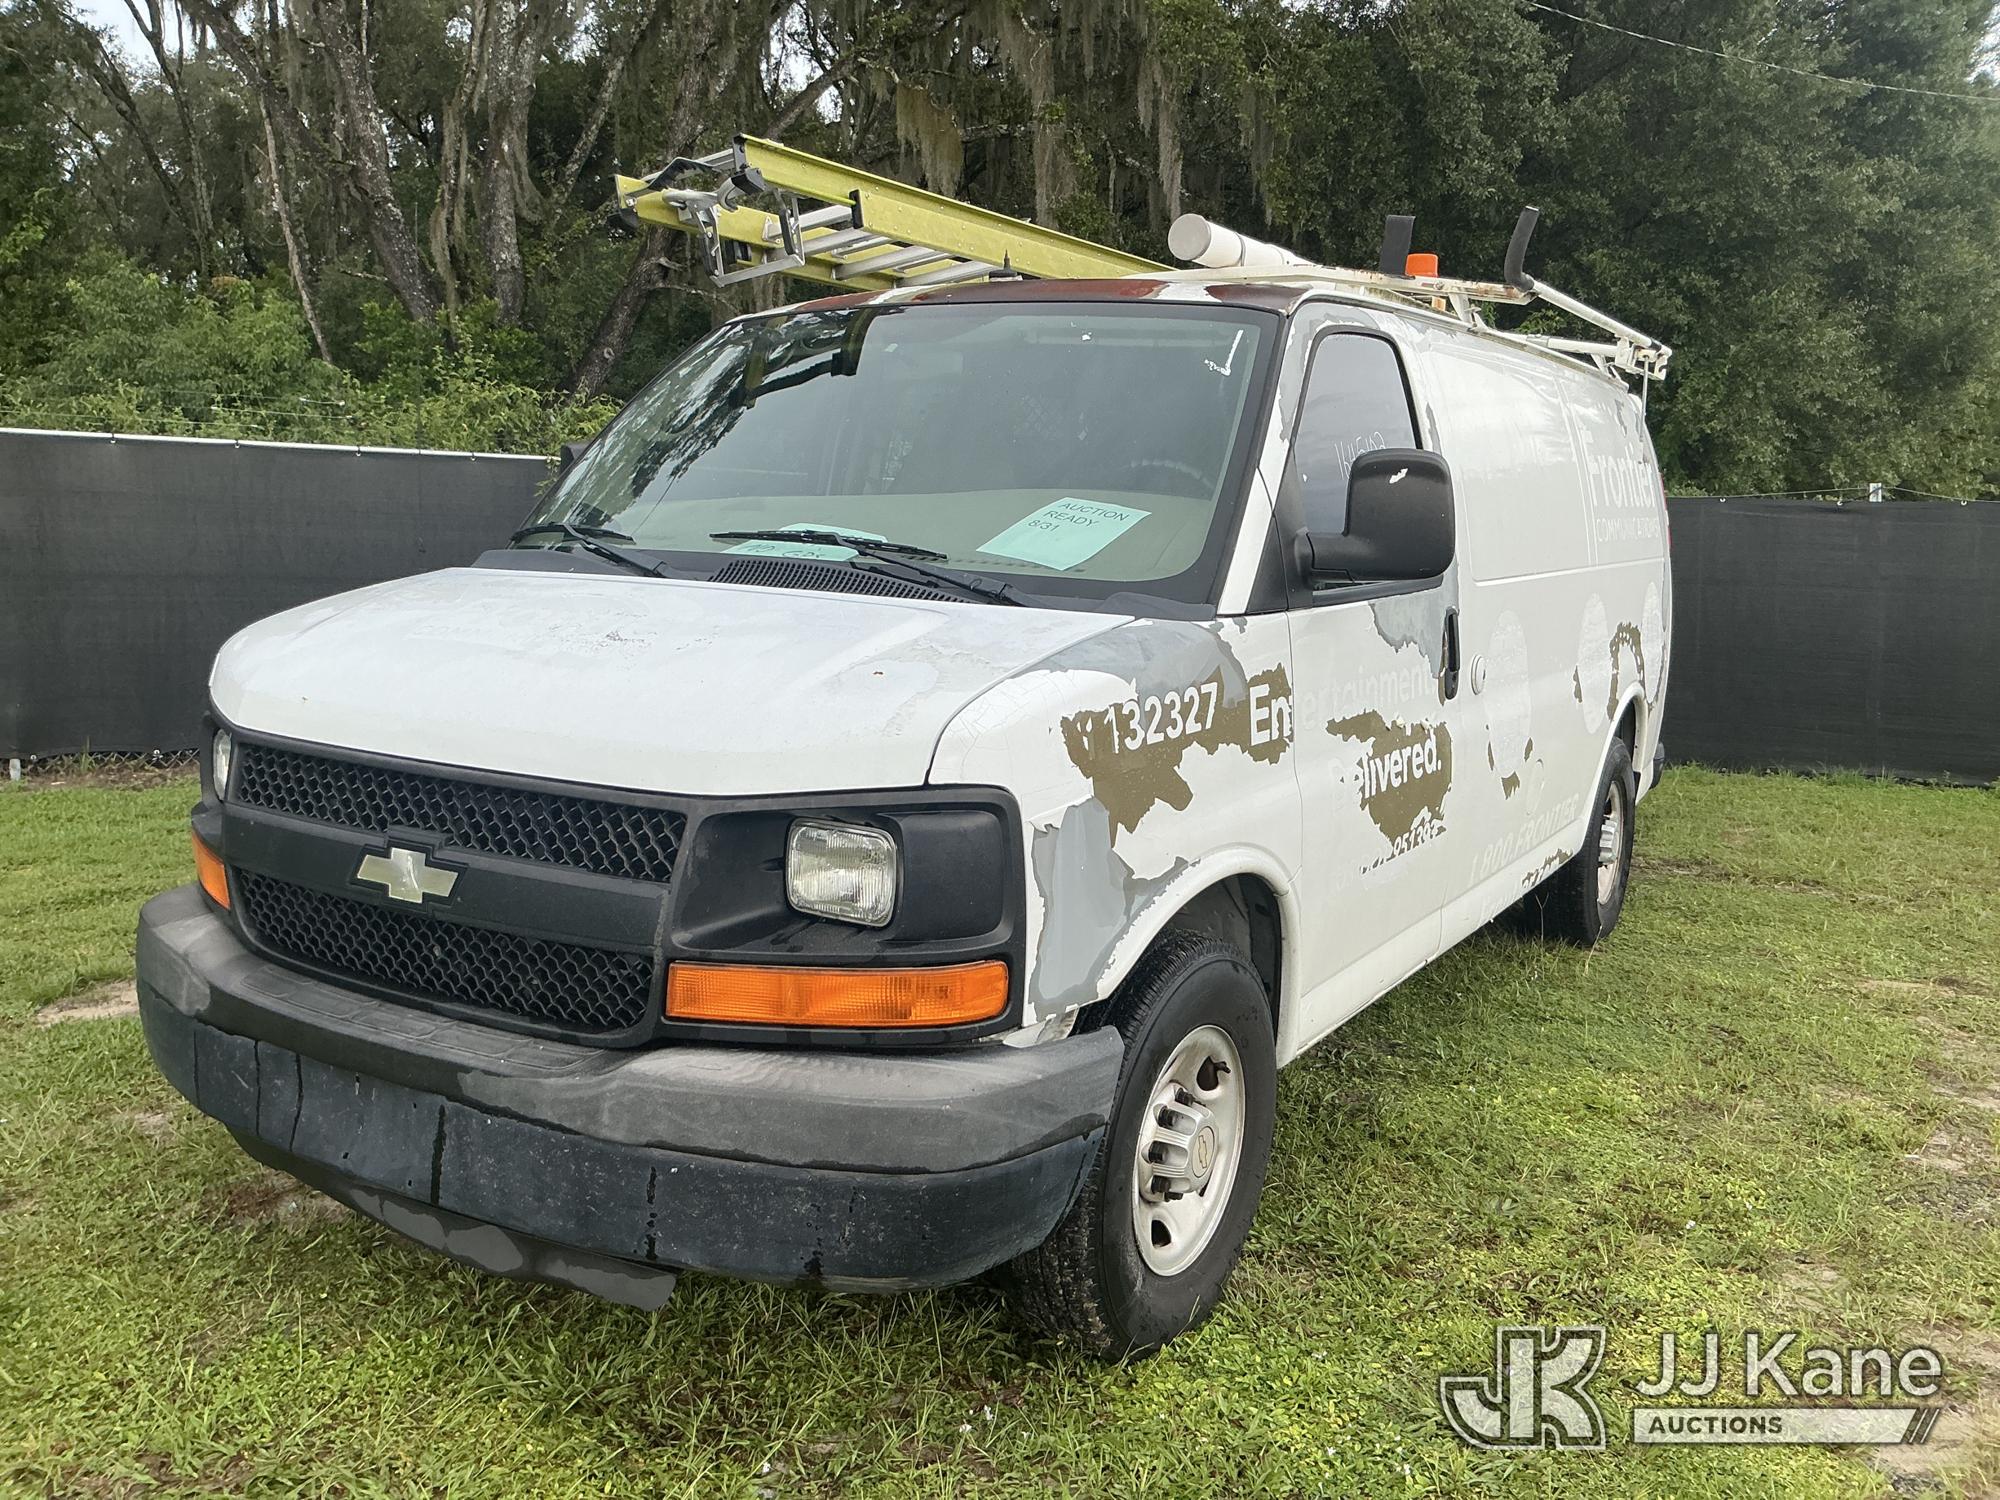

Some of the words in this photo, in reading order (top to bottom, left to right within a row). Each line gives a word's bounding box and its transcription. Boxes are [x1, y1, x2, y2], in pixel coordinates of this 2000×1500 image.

[1043, 510, 1100, 528] READY
[1058, 502, 1130, 522] AUCTION
[1028, 519, 1060, 532] 8/31
[1104, 681, 1218, 754] 132327
